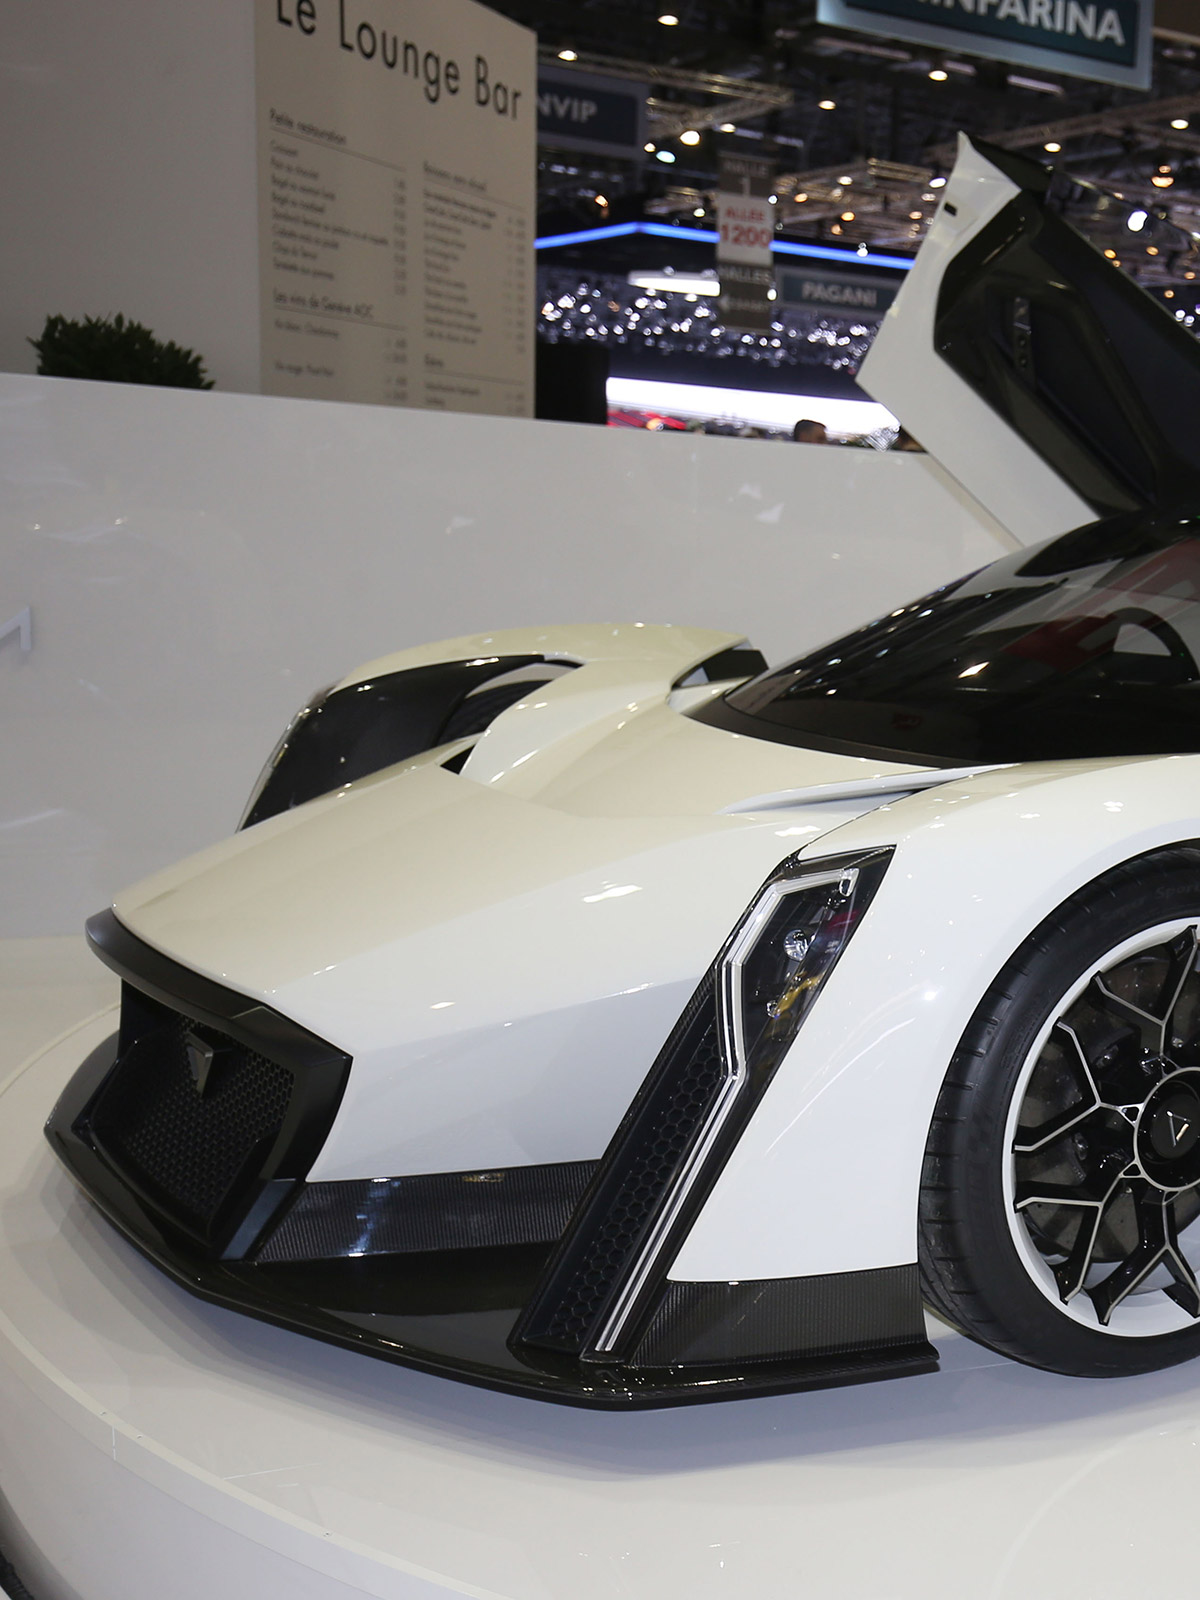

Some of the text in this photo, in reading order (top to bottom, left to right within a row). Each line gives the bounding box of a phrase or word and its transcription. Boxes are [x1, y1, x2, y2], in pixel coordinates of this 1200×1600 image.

[339, 0, 460, 103] Lounge
[475, 55, 521, 119] Bar
[721, 223, 771, 249] 1200
[802, 281, 878, 307] PAGANI
